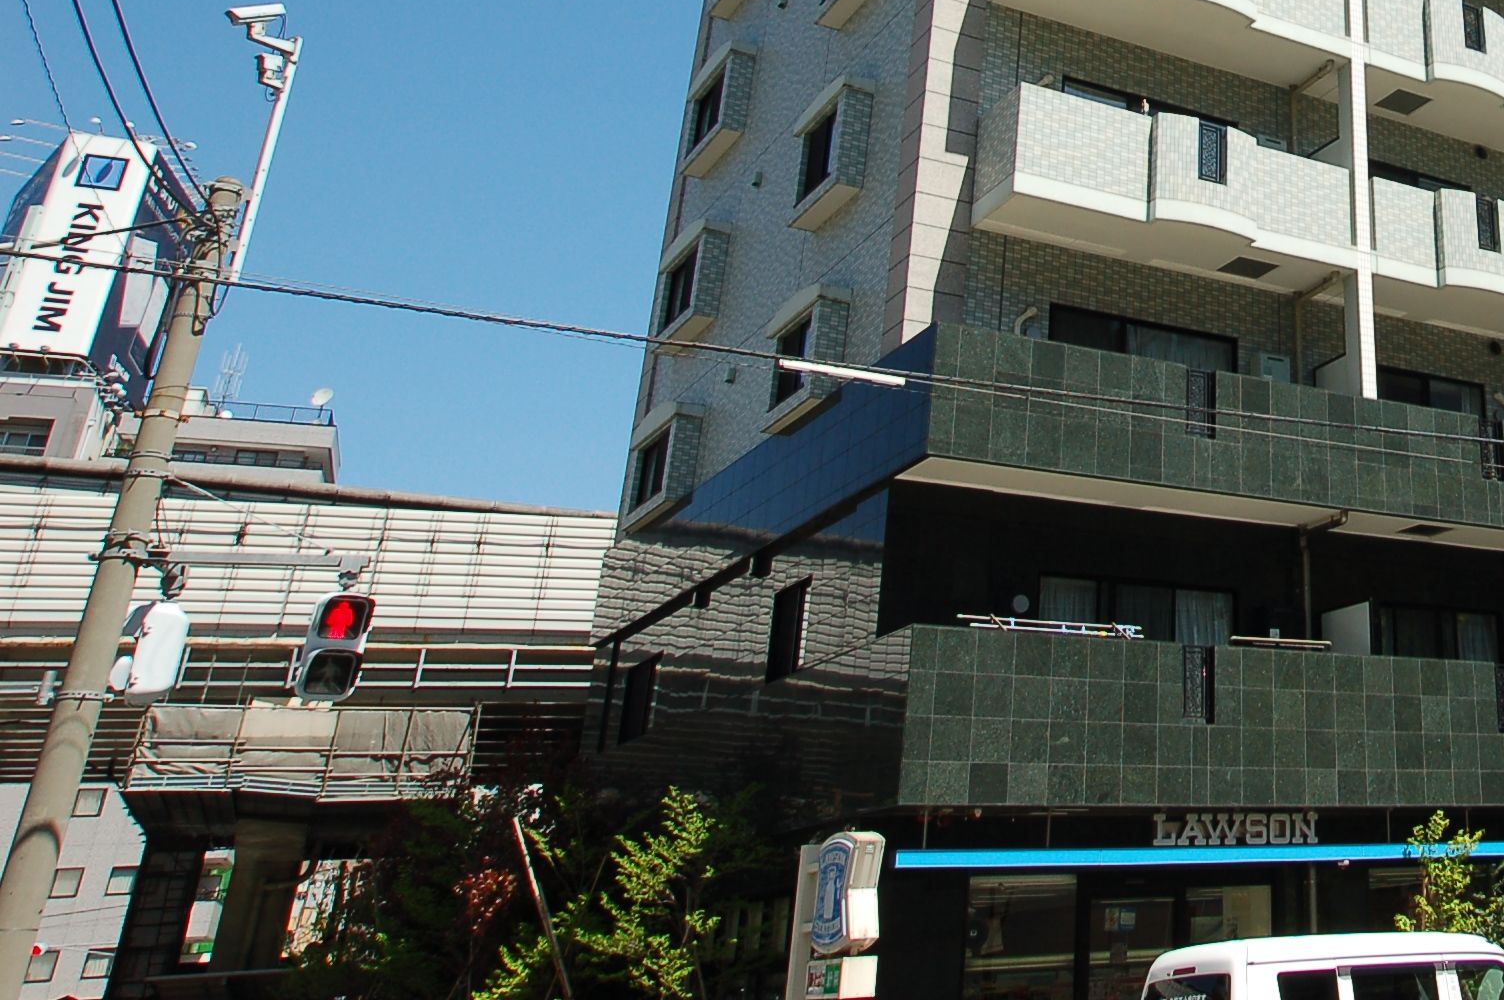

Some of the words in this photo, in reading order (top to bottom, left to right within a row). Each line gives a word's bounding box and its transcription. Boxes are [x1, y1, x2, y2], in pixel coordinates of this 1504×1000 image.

[53, 202, 105, 275] KING
[32, 281, 75, 333] JIM
[1152, 811, 1319, 846] LAWSON
